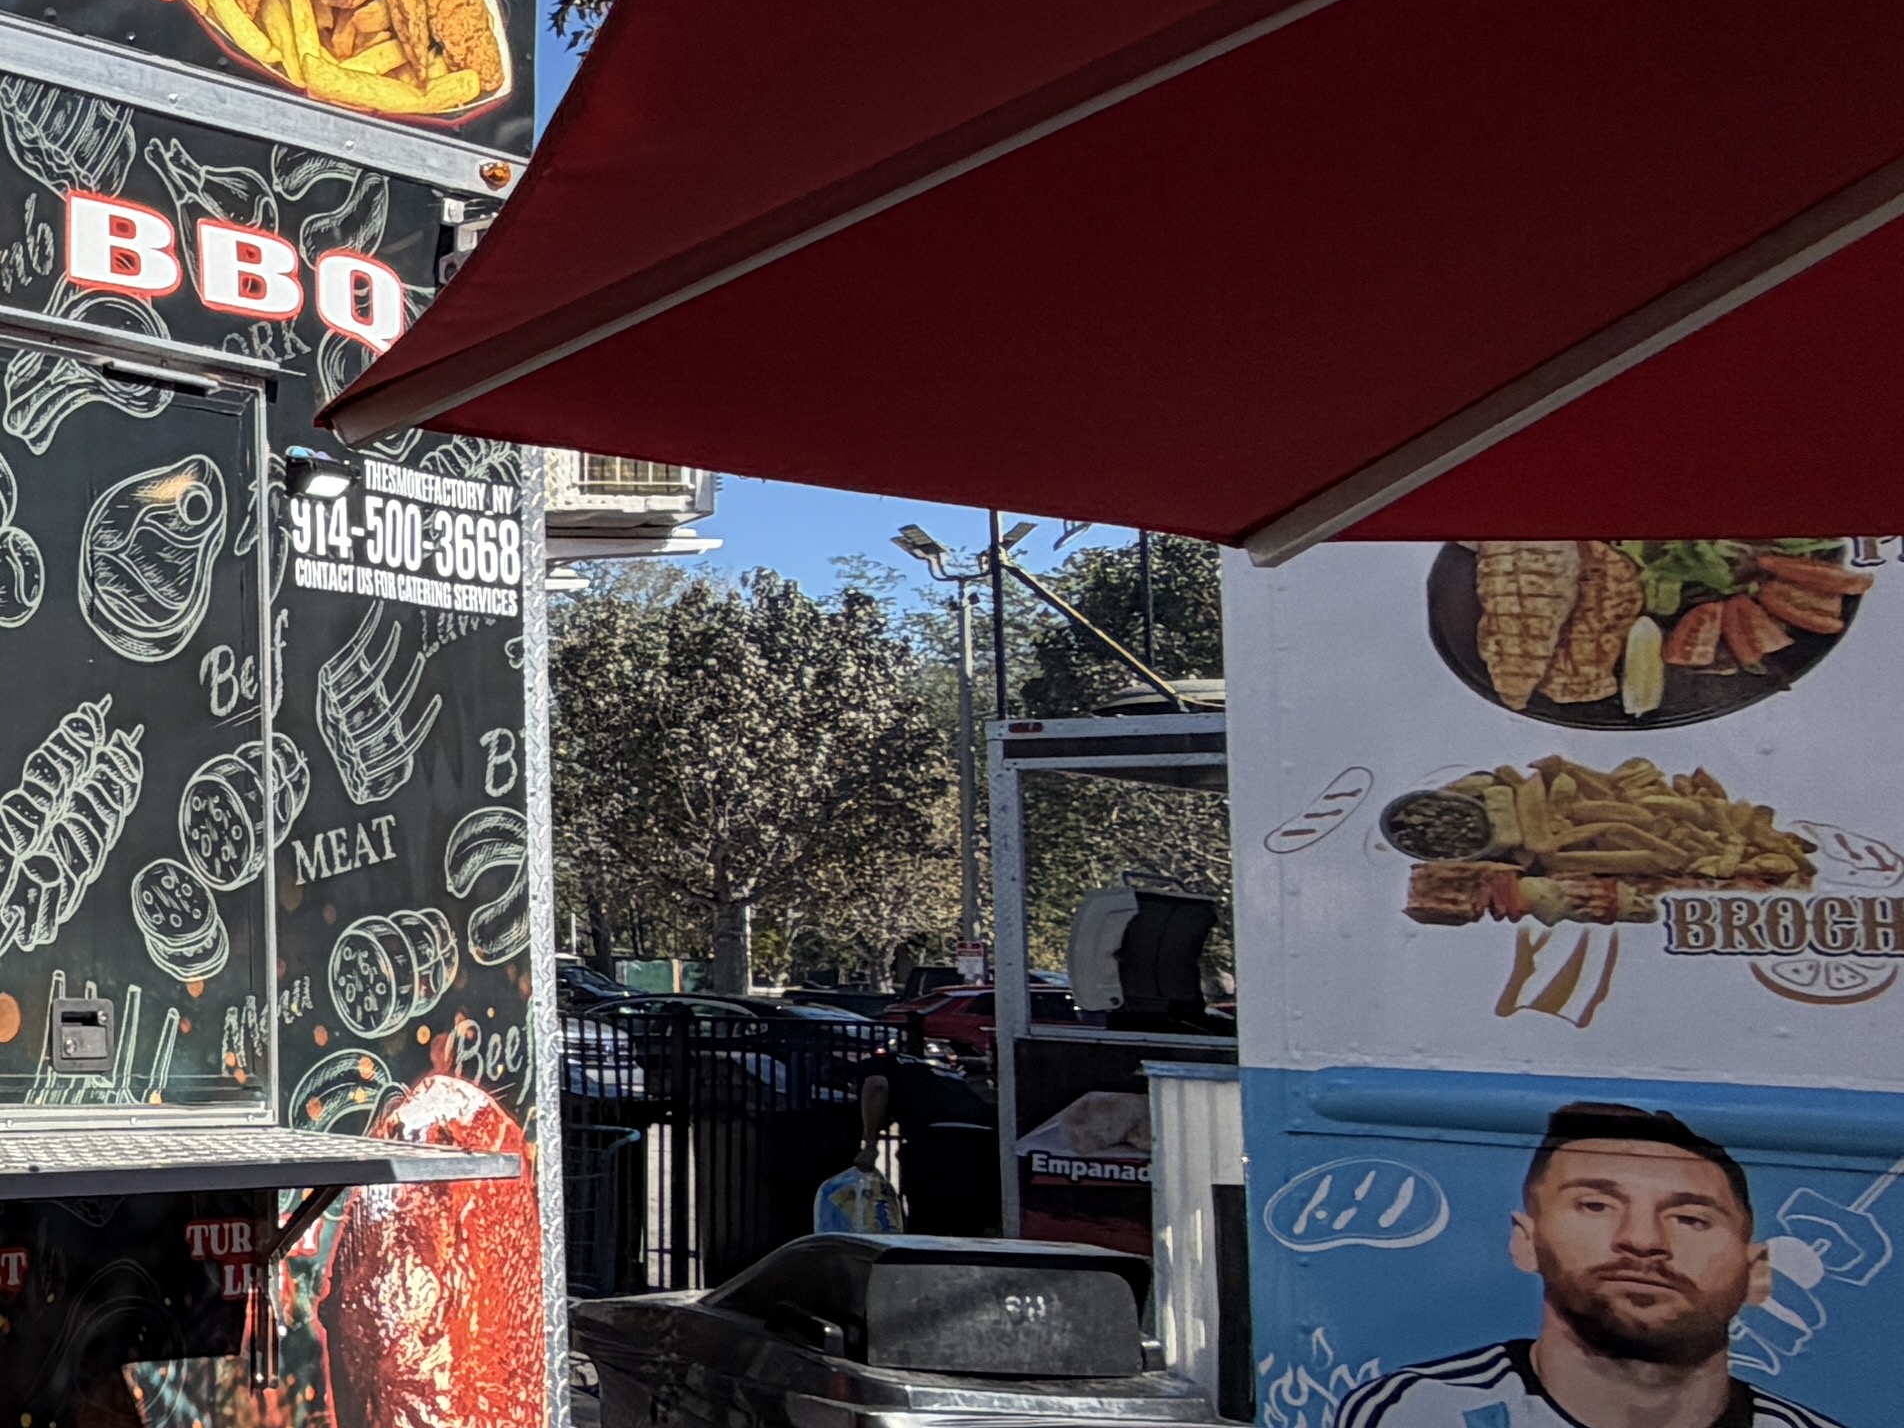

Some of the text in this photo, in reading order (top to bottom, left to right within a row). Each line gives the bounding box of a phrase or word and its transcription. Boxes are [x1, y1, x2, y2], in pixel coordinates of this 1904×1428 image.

[68, 193, 403, 354] BBQ
[291, 496, 521, 585] 914-500-3668
[295, 558, 518, 617] CONTACT US FOR CATERING SERVICES
[200, 608, 289, 720] Bef
[291, 815, 397, 886] MEAT
